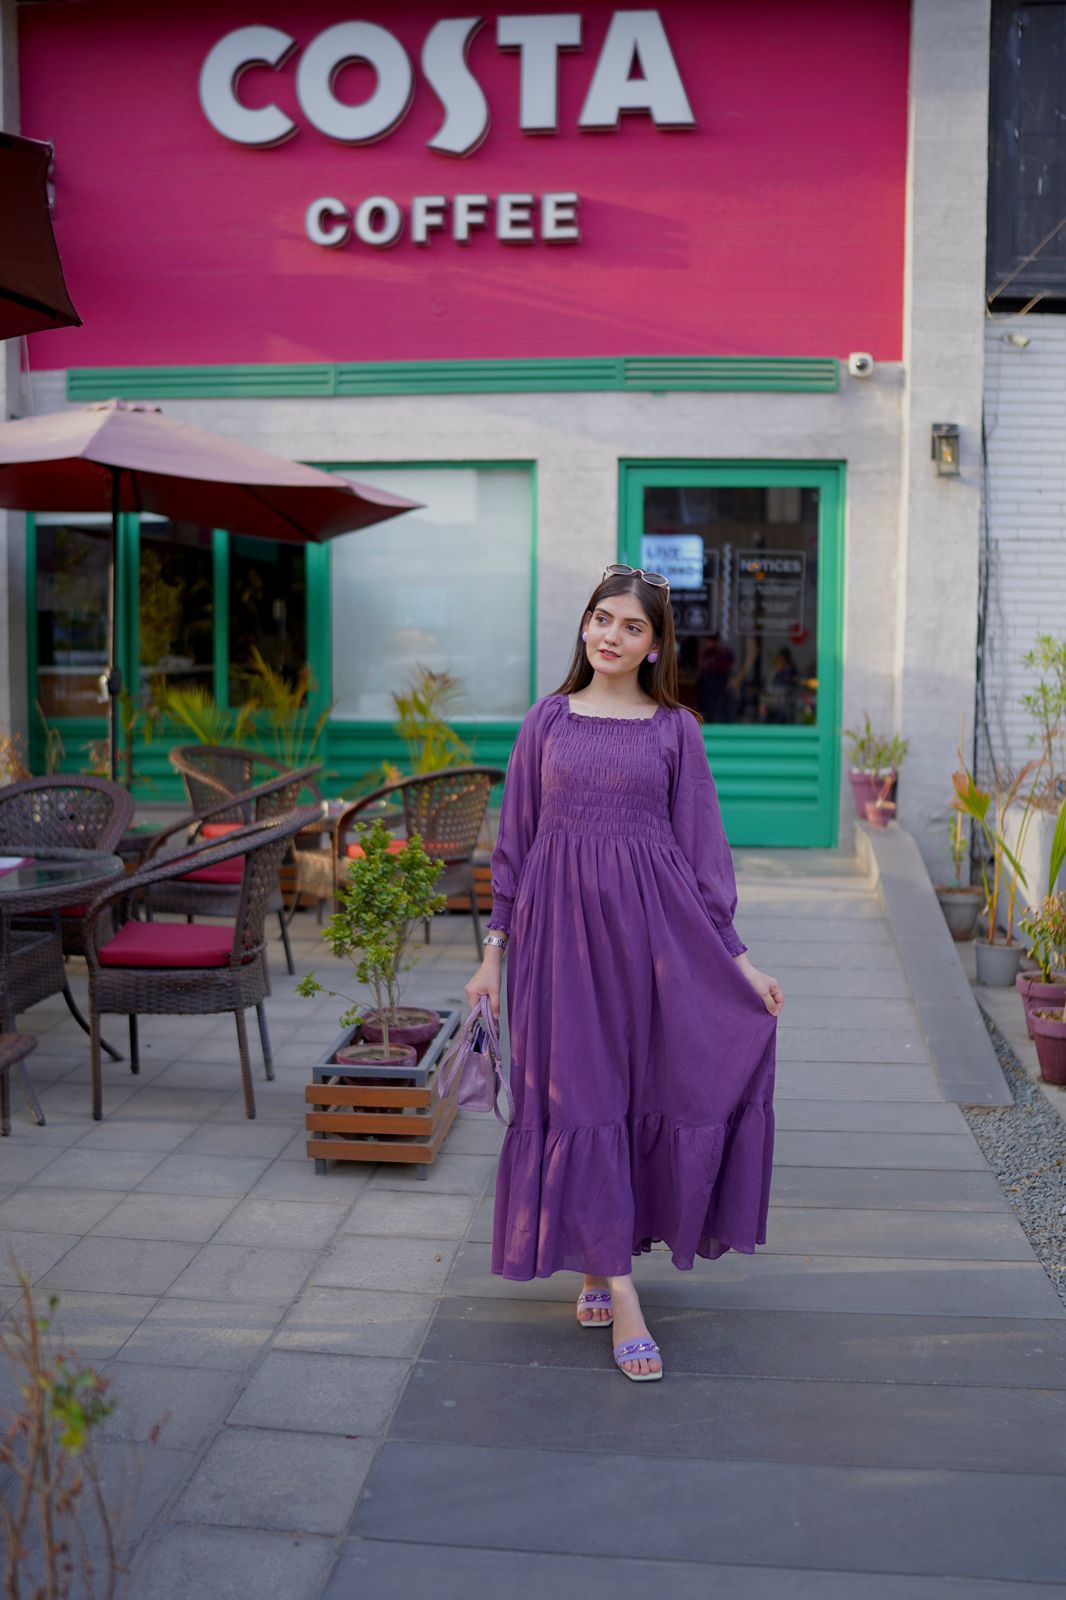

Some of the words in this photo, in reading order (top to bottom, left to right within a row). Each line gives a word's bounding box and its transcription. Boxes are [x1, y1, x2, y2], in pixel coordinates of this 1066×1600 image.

[199, 9, 697, 158] COSTA
[306, 192, 580, 248] COFFEE
[740, 558, 802, 573] NOTICES
